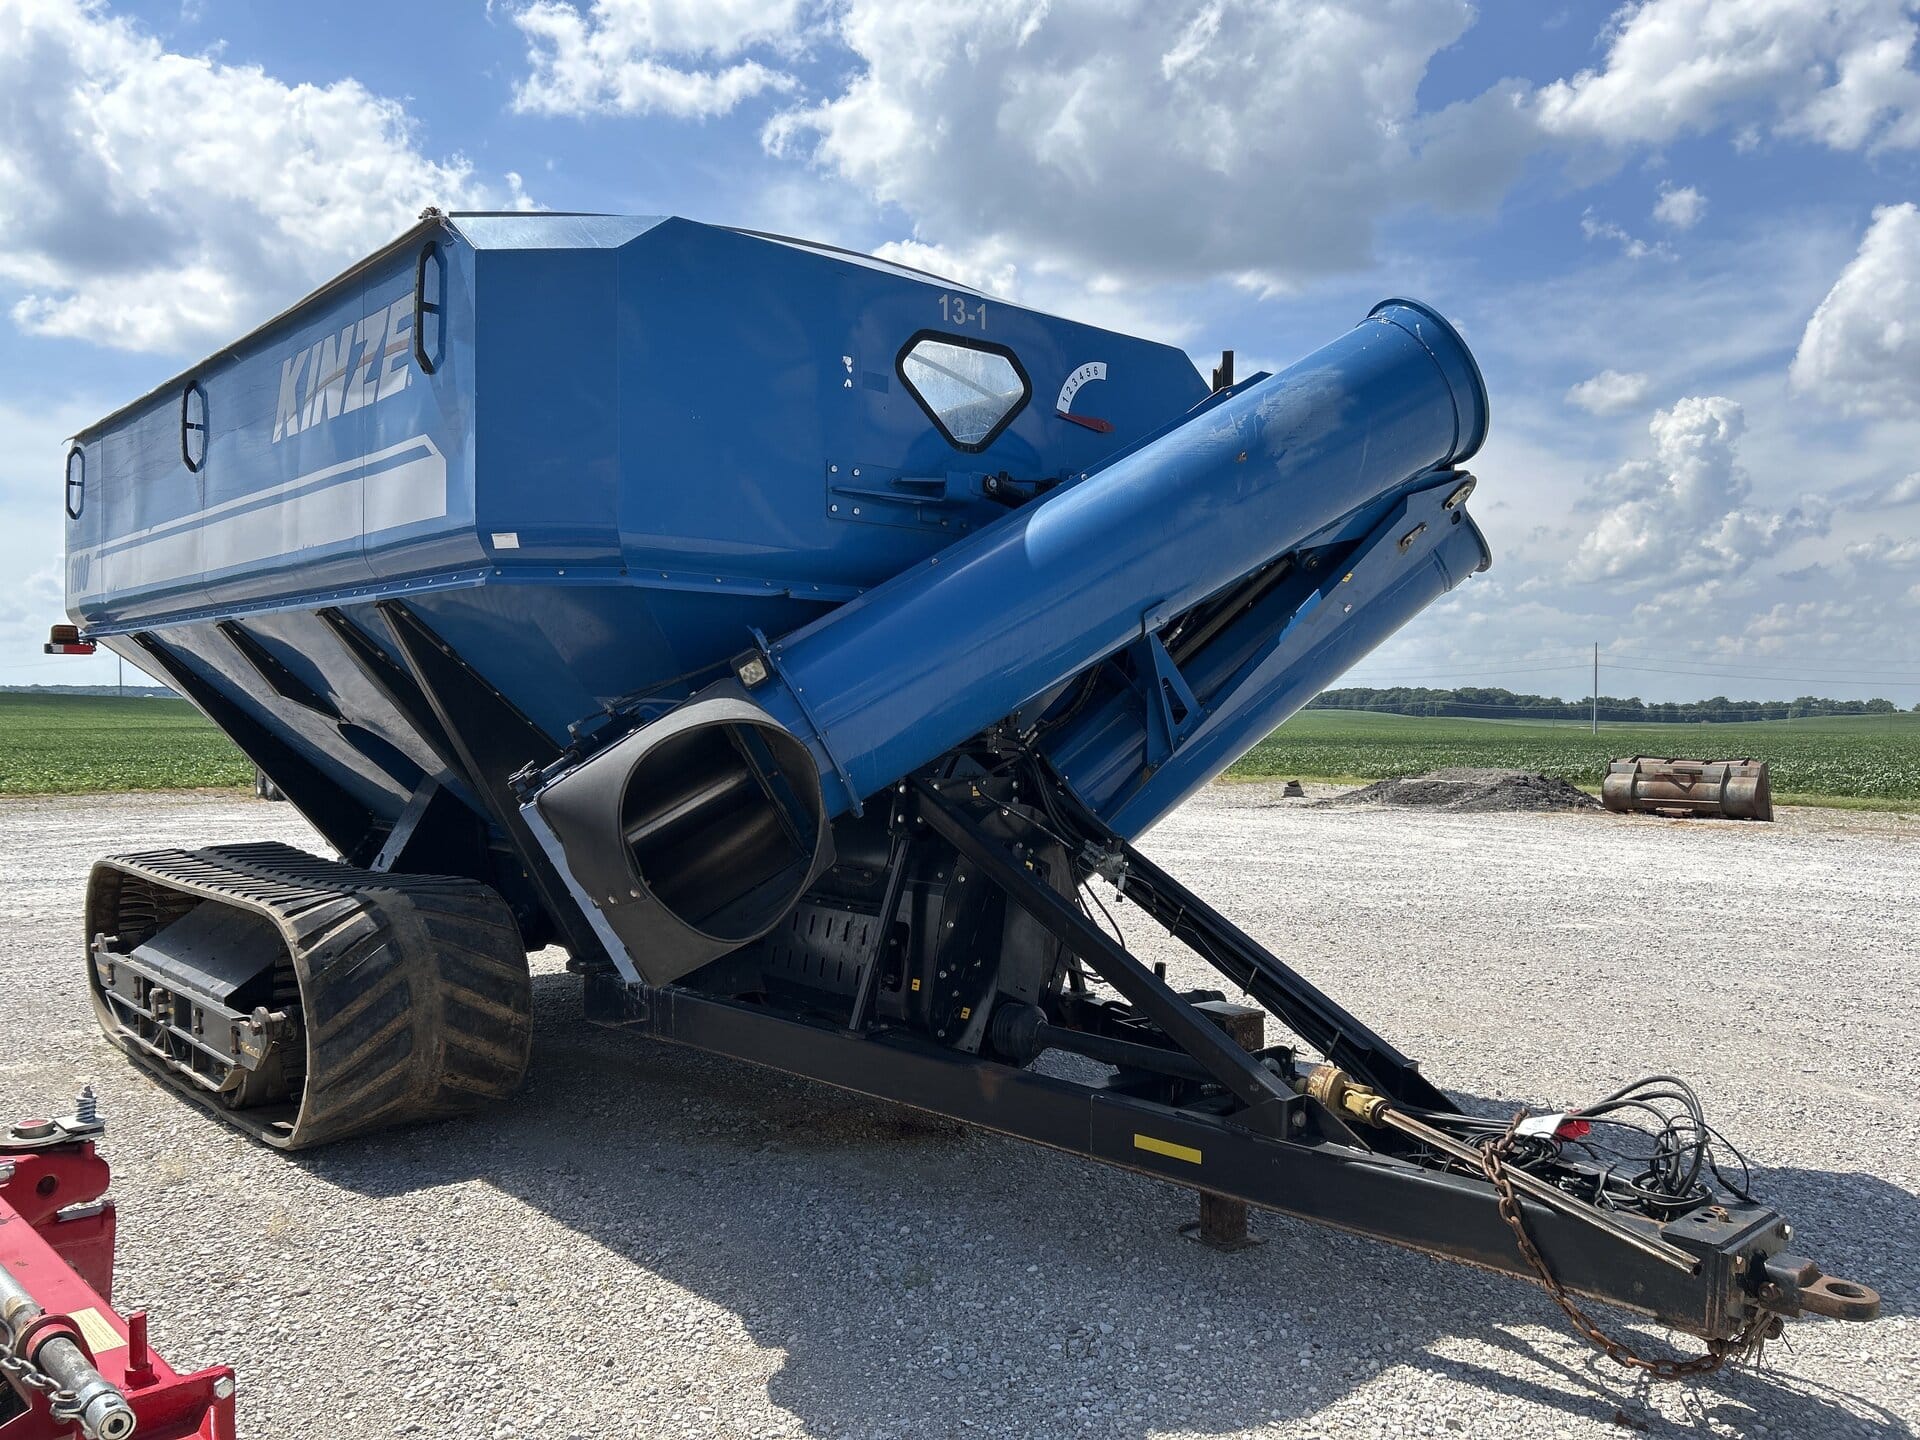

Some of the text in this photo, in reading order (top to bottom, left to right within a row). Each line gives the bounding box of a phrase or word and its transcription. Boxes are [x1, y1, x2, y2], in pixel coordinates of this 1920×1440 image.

[938, 294, 986, 330] 13-1
[272, 291, 415, 444] KINZE
[1066, 386, 1073, 395] 2
[1071, 377, 1078, 387] 3
[1085, 367, 1091, 377] 5
[1093, 366, 1098, 376] 6
